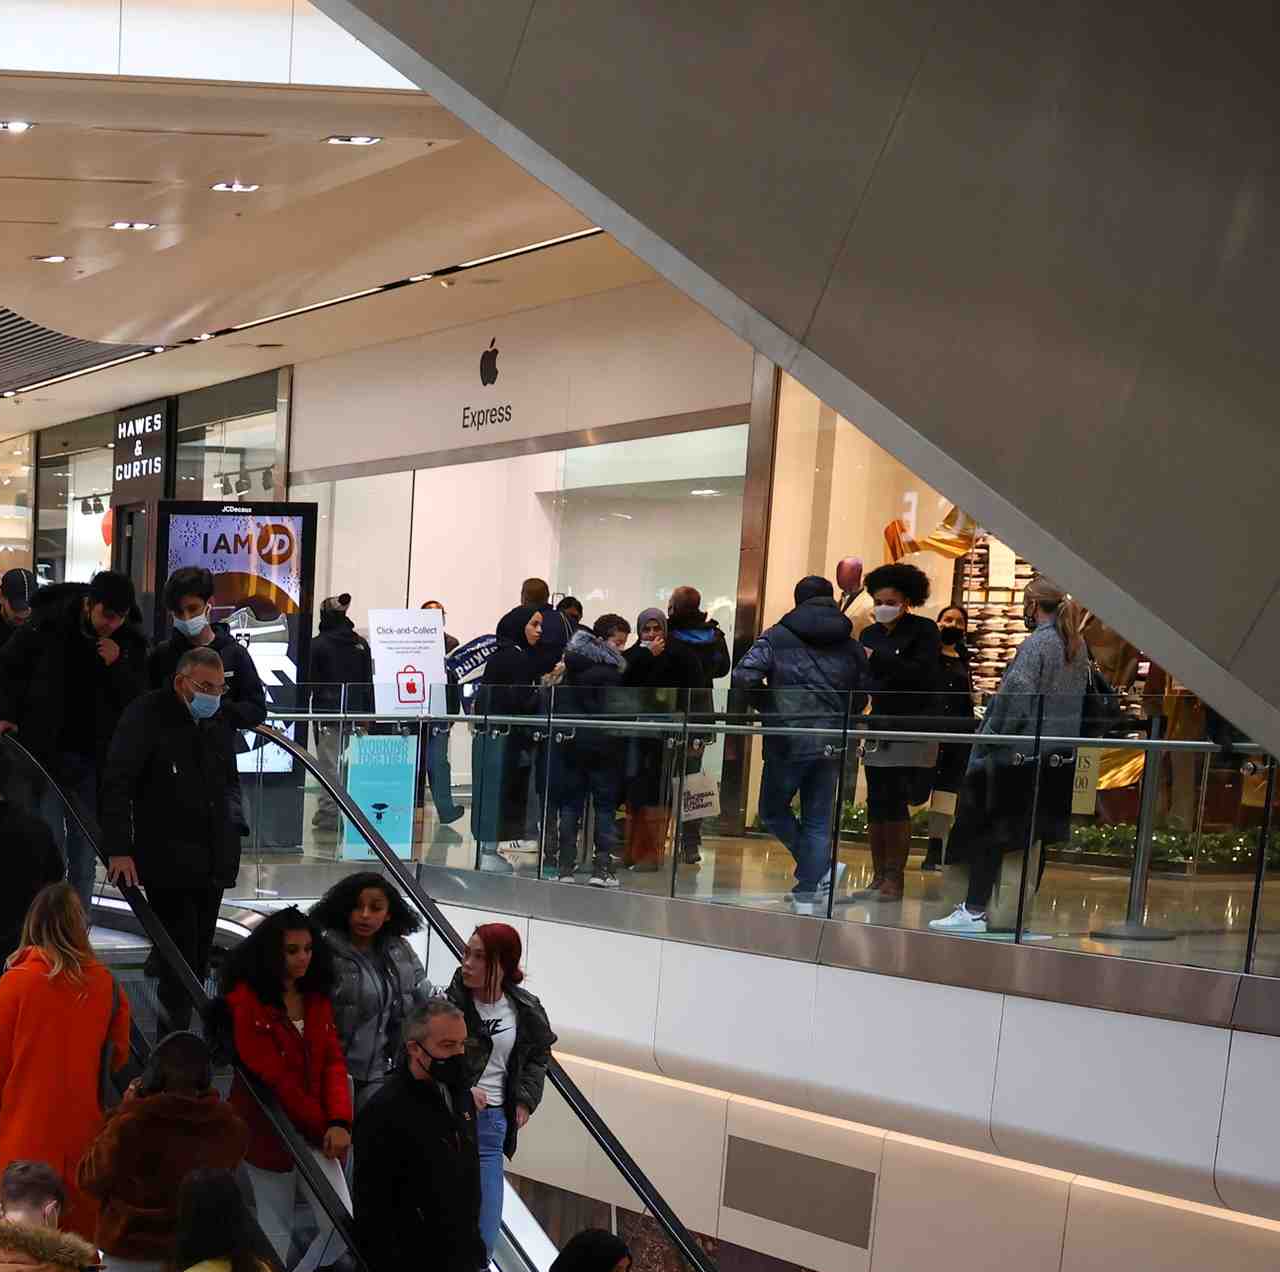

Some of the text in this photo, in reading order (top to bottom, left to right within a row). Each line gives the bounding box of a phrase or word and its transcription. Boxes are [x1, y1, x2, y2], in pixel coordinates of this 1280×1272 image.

[117, 413, 163, 439] HAWES
[461, 404, 512, 431] Express
[133, 439, 143, 457] &
[114, 456, 162, 481] CURTIS
[202, 532, 290, 556] I AM JD
[376, 625, 438, 635] Click-and-Collect
